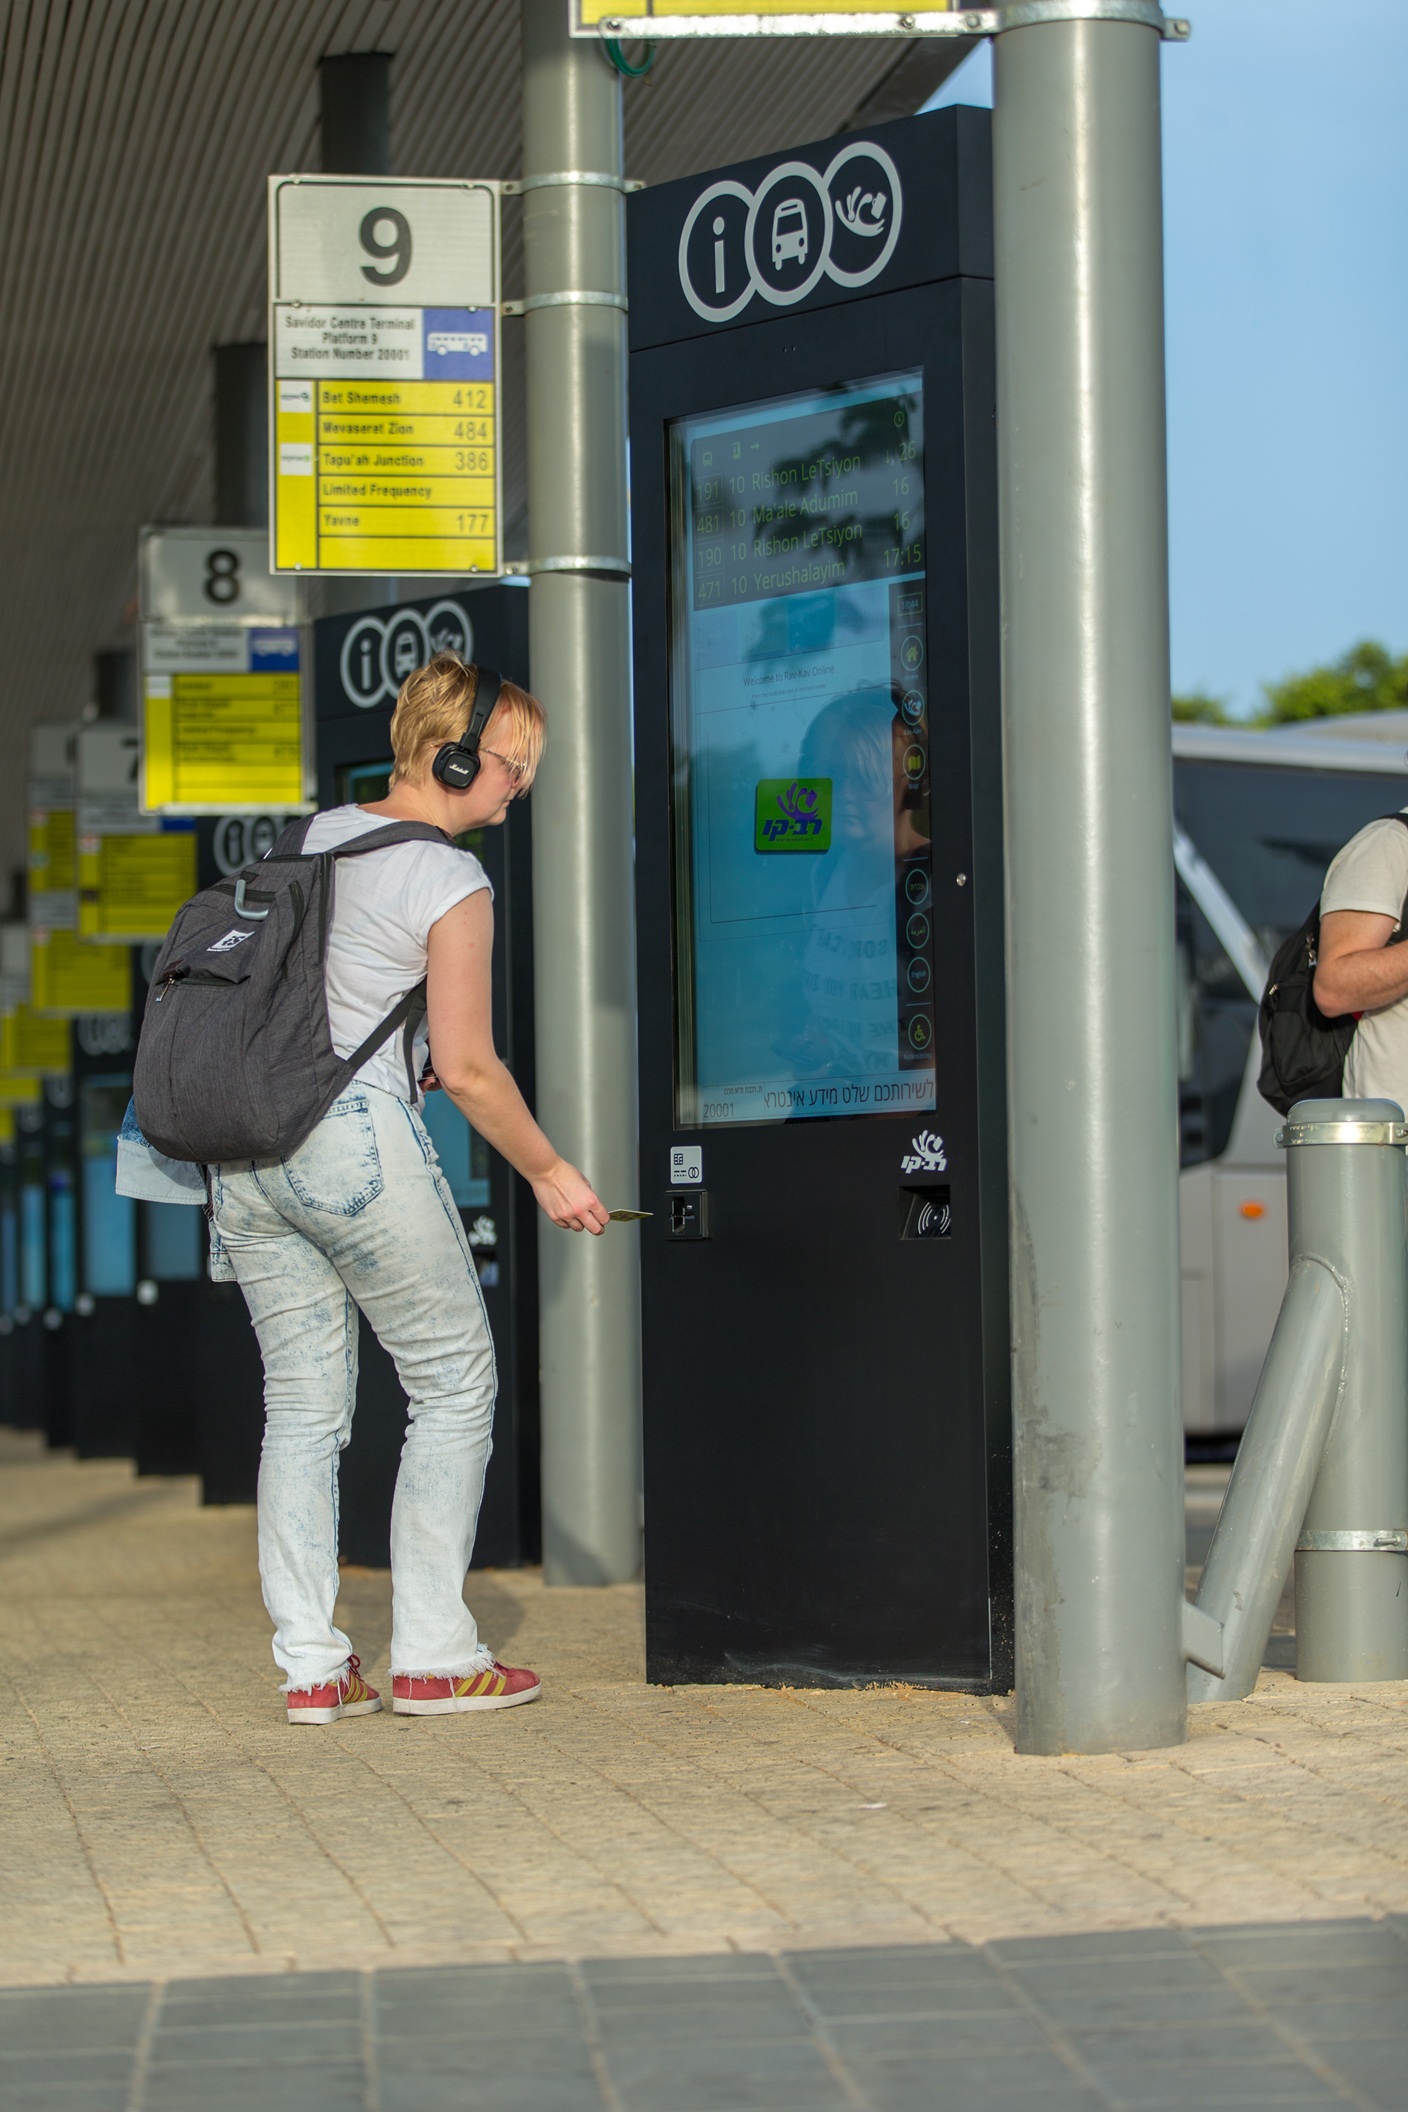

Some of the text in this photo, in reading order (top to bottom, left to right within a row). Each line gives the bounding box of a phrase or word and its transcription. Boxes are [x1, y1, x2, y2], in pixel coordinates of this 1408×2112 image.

[360, 206, 412, 287] 9
[285, 316, 415, 330] Savidor Centre Terminal
[322, 332, 378, 345] Platform 9
[291, 347, 410, 361] Station Number 20001
[322, 391, 343, 404] Bet
[346, 391, 400, 406] Shemesh
[453, 389, 487, 409] 412
[323, 422, 414, 435] Mevaseret Zion
[454, 421, 488, 441] 484
[323, 452, 369, 468] Tapu'ah
[373, 453, 424, 467] Junction
[454, 451, 488, 471] 386
[697, 440, 916, 502] 191 10 Rishon LeTsiyon 26
[323, 484, 432, 500] Limited Frequency
[697, 476, 909, 535] 481 10 Ma'ale Adumim 16
[324, 514, 360, 527] Yavne
[456, 513, 489, 533] 177
[698, 511, 910, 568] 190 10 Rishon LeTsiyon 16
[204, 549, 241, 604] 8
[697, 544, 922, 602] 471 10 Yerushalayim 17:15
[743, 665, 835, 687] Welcome to Rav-Kav Online
[911, 970, 927, 979] English
[808, 1087, 838, 1107] מידע
[842, 1083, 870, 1104] שלט
[874, 1080, 934, 1102] לשירותכם
[703, 1103, 734, 1119] 20001
